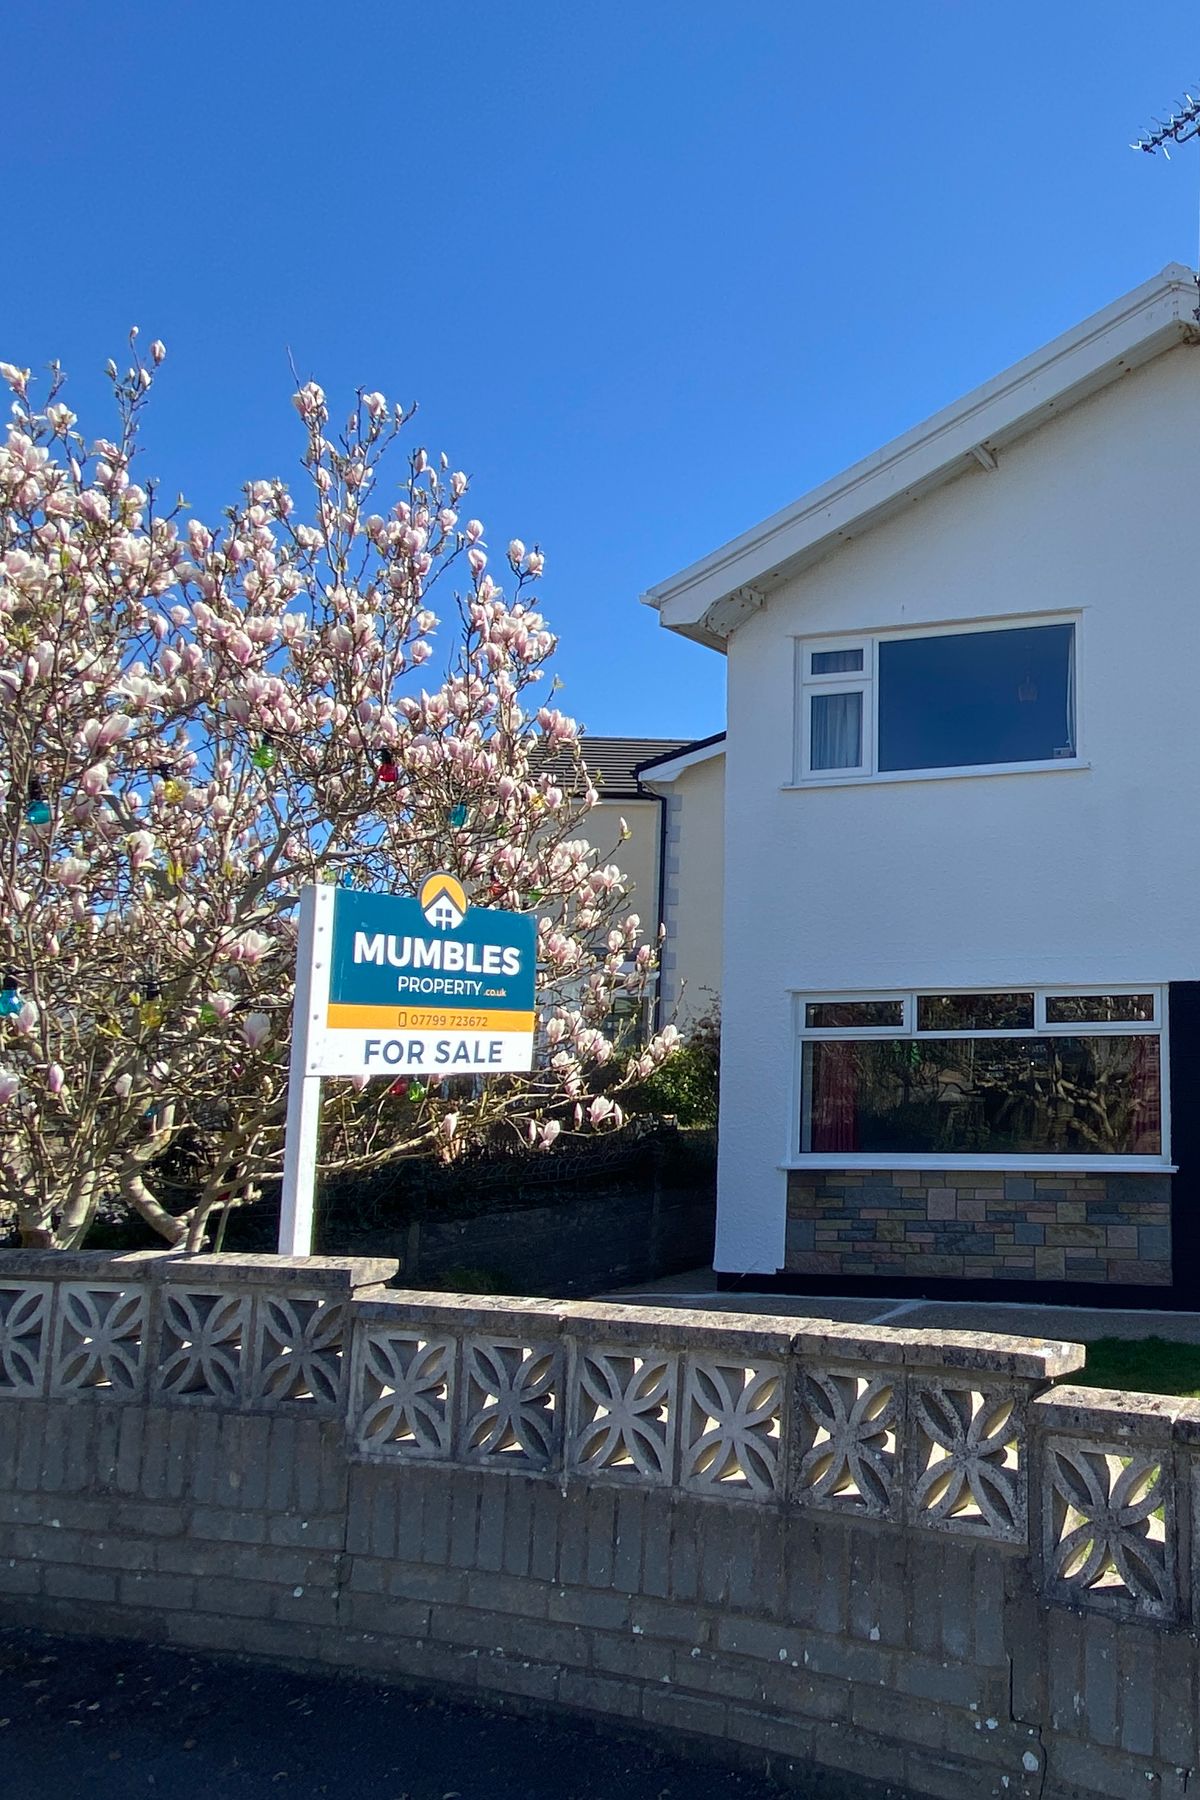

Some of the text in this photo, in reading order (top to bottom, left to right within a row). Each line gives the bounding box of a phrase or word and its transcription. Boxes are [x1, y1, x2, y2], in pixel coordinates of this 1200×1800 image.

[353, 931, 521, 976] MUMBLES
[397, 975, 483, 996] PROPERTY
[410, 1014, 488, 1027] 07799 723672
[363, 1039, 503, 1065] FOR SALE
